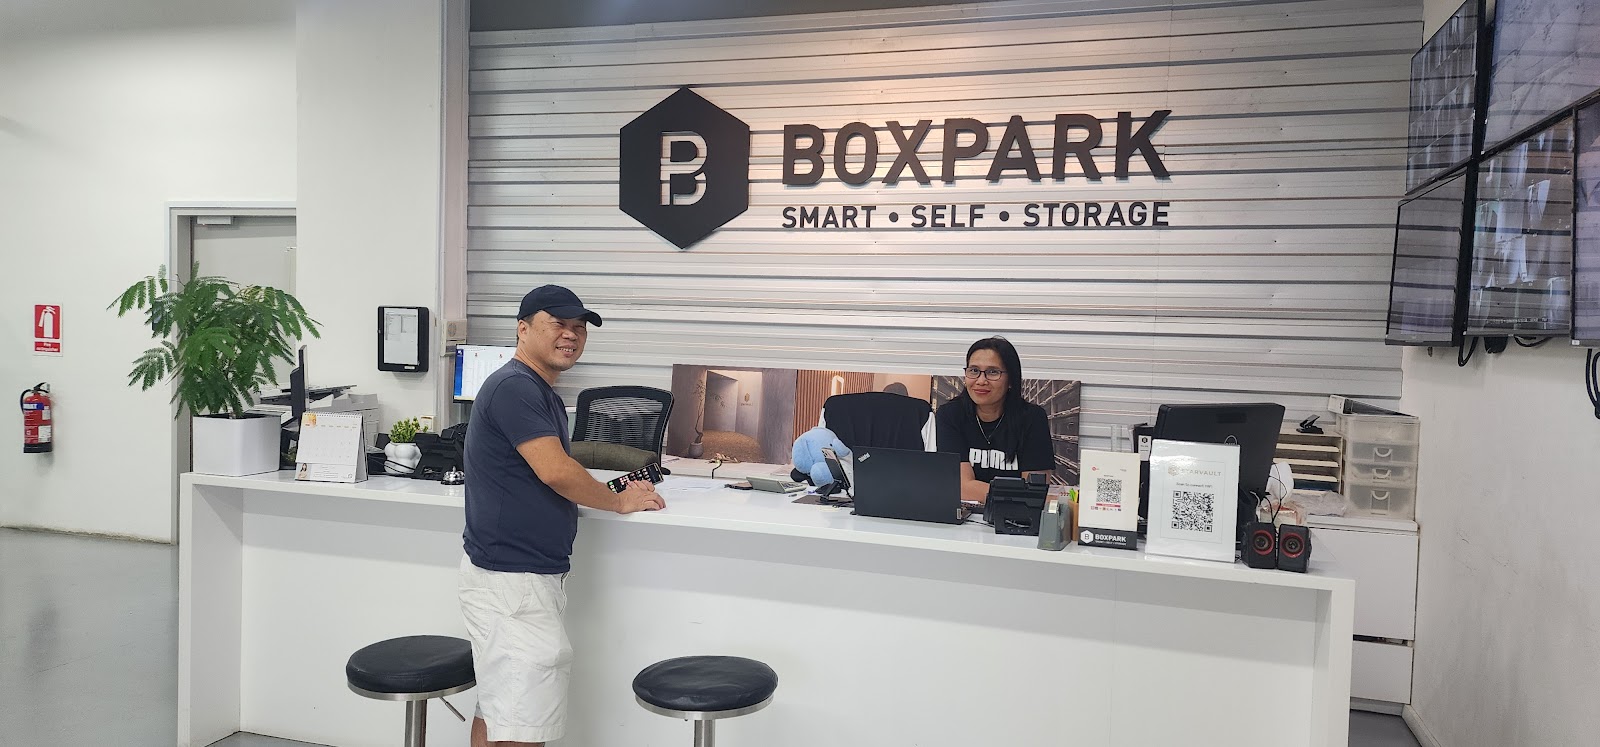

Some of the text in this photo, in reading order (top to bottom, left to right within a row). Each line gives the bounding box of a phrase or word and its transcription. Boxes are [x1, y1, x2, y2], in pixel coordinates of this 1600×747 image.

[782, 109, 1172, 185] BOXPARK
[782, 201, 1171, 229] SMART SELF STORAGE
[1094, 533, 1127, 543] BOXPARK
